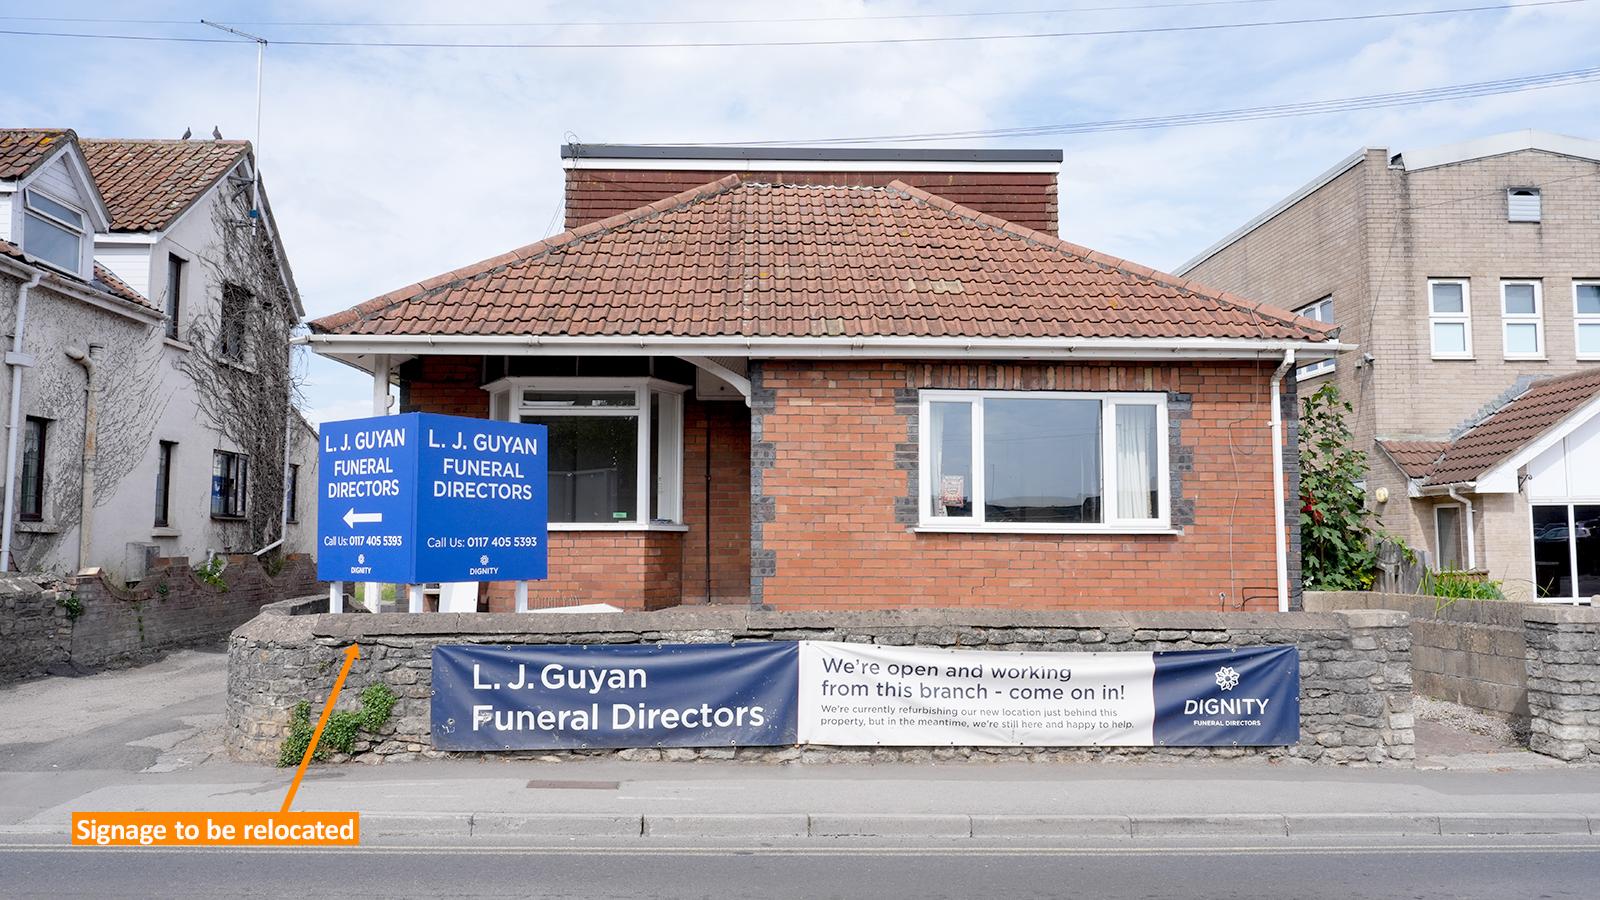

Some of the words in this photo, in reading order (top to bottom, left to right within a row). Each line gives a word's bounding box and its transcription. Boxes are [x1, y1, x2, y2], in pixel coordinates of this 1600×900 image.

[325, 435, 337, 452] L.
[340, 433, 351, 451] J.
[354, 428, 406, 449] GUYAN
[428, 429, 446, 449] L.
[452, 431, 467, 450] J.
[473, 433, 538, 455] GUYAN
[334, 457, 393, 476] FUNERAL
[443, 458, 525, 478] FUNERAL
[328, 479, 400, 498] DIRECTORS
[433, 480, 532, 500] DIRECTORS
[323, 535, 337, 546] Call
[337, 535, 348, 546] Us:
[349, 535, 364, 546] 0117
[366, 535, 382, 546] 405
[383, 535, 403, 546] 5393
[427, 537, 447, 548] Call
[449, 537, 465, 548] Us:
[467, 536, 488, 548] 0117
[491, 536, 512, 547] 405
[513, 536, 538, 547] 5393
[350, 566, 372, 574] DIGNITY
[469, 567, 499, 575] DIGNITY
[472, 663, 501, 690] L.
[507, 663, 534, 690] J.
[540, 663, 647, 695] Guyan
[822, 657, 880, 675] We're
[887, 663, 939, 679] open
[945, 663, 983, 679] and
[991, 665, 1072, 682] working
[821, 680, 869, 697] from
[876, 682, 913, 698] this
[920, 682, 988, 699] branch
[1009, 686, 1064, 700] come
[1070, 686, 1095, 700] on
[1102, 684, 1125, 700] in!
[821, 704, 850, 714] We're
[852, 704, 896, 715] currently
[898, 705, 958, 717] refurbishing
[961, 708, 977, 716] our
[980, 709, 1000, 717] new
[1002, 708, 1041, 717] location
[1043, 708, 1061, 718] just
[1064, 708, 1097, 717] behind
[1100, 708, 1118, 717] this
[1183, 698, 1270, 715] DIGNITY
[472, 703, 599, 731] Funeral
[611, 702, 765, 730] Directors
[820, 717, 866, 727] property,
[868, 717, 885, 726] but
[887, 717, 897, 726] in
[899, 717, 916, 726] the
[918, 718, 970, 728] meantime,
[972, 720, 999, 728] we're
[1001, 720, 1019, 729] still
[1021, 720, 1043, 729] here
[1045, 720, 1064, 729] and
[1066, 720, 1096, 730] happy
[1099, 721, 1109, 729] to
[1111, 720, 1135, 730] help.
